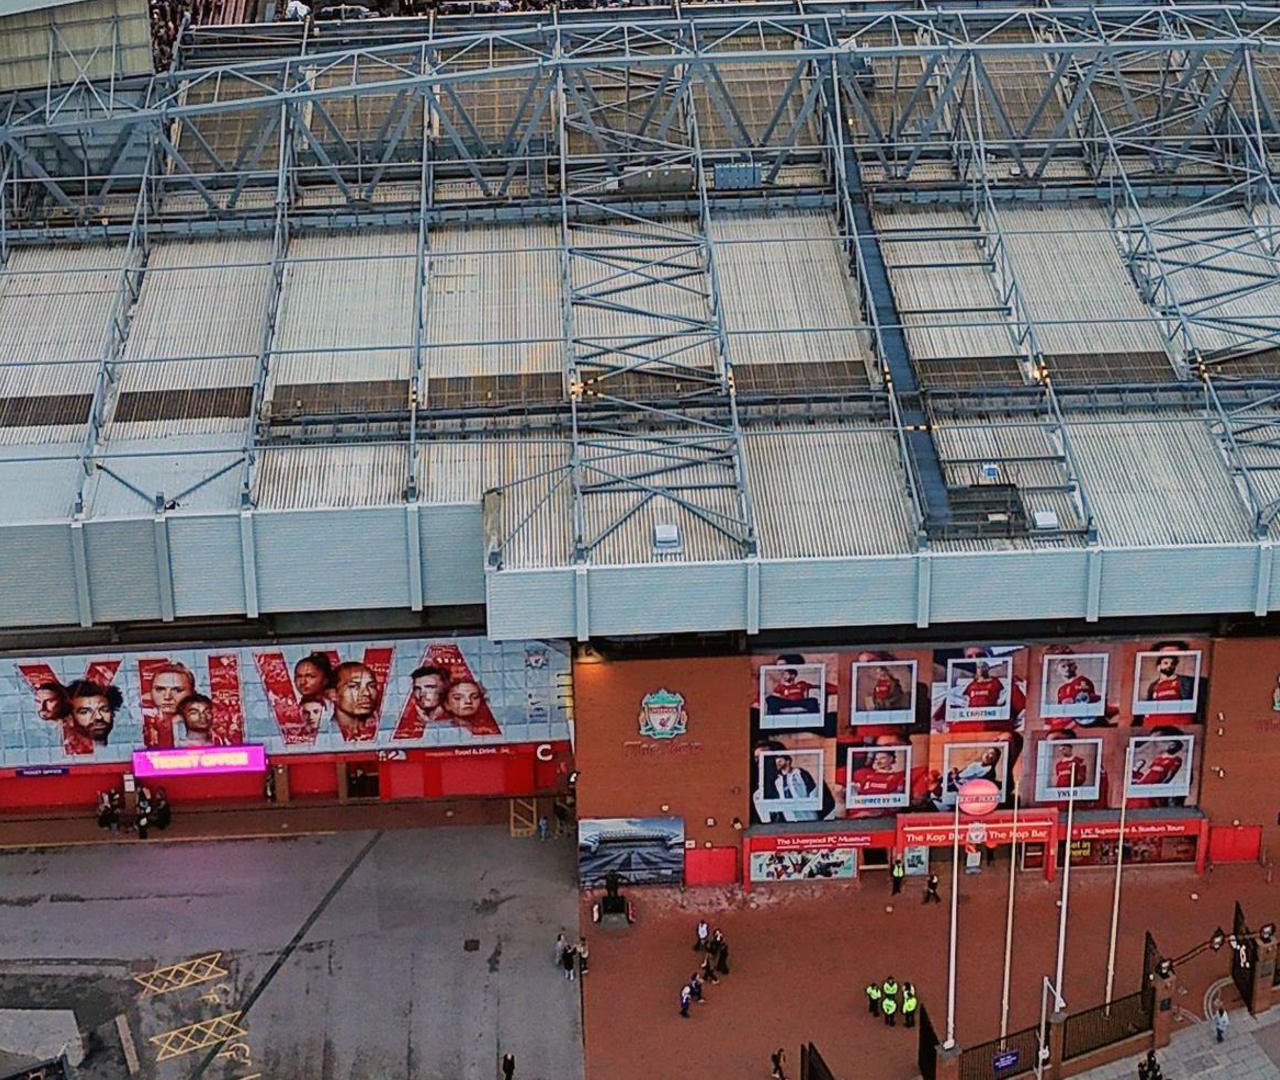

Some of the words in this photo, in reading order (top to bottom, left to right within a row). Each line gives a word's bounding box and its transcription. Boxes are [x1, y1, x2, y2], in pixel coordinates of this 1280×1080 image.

[536, 744, 553, 761] C
[906, 834, 924, 842] The
[926, 833, 946, 842] Kop
[989, 831, 1007, 839] The
[1031, 829, 1048, 838] Bar
